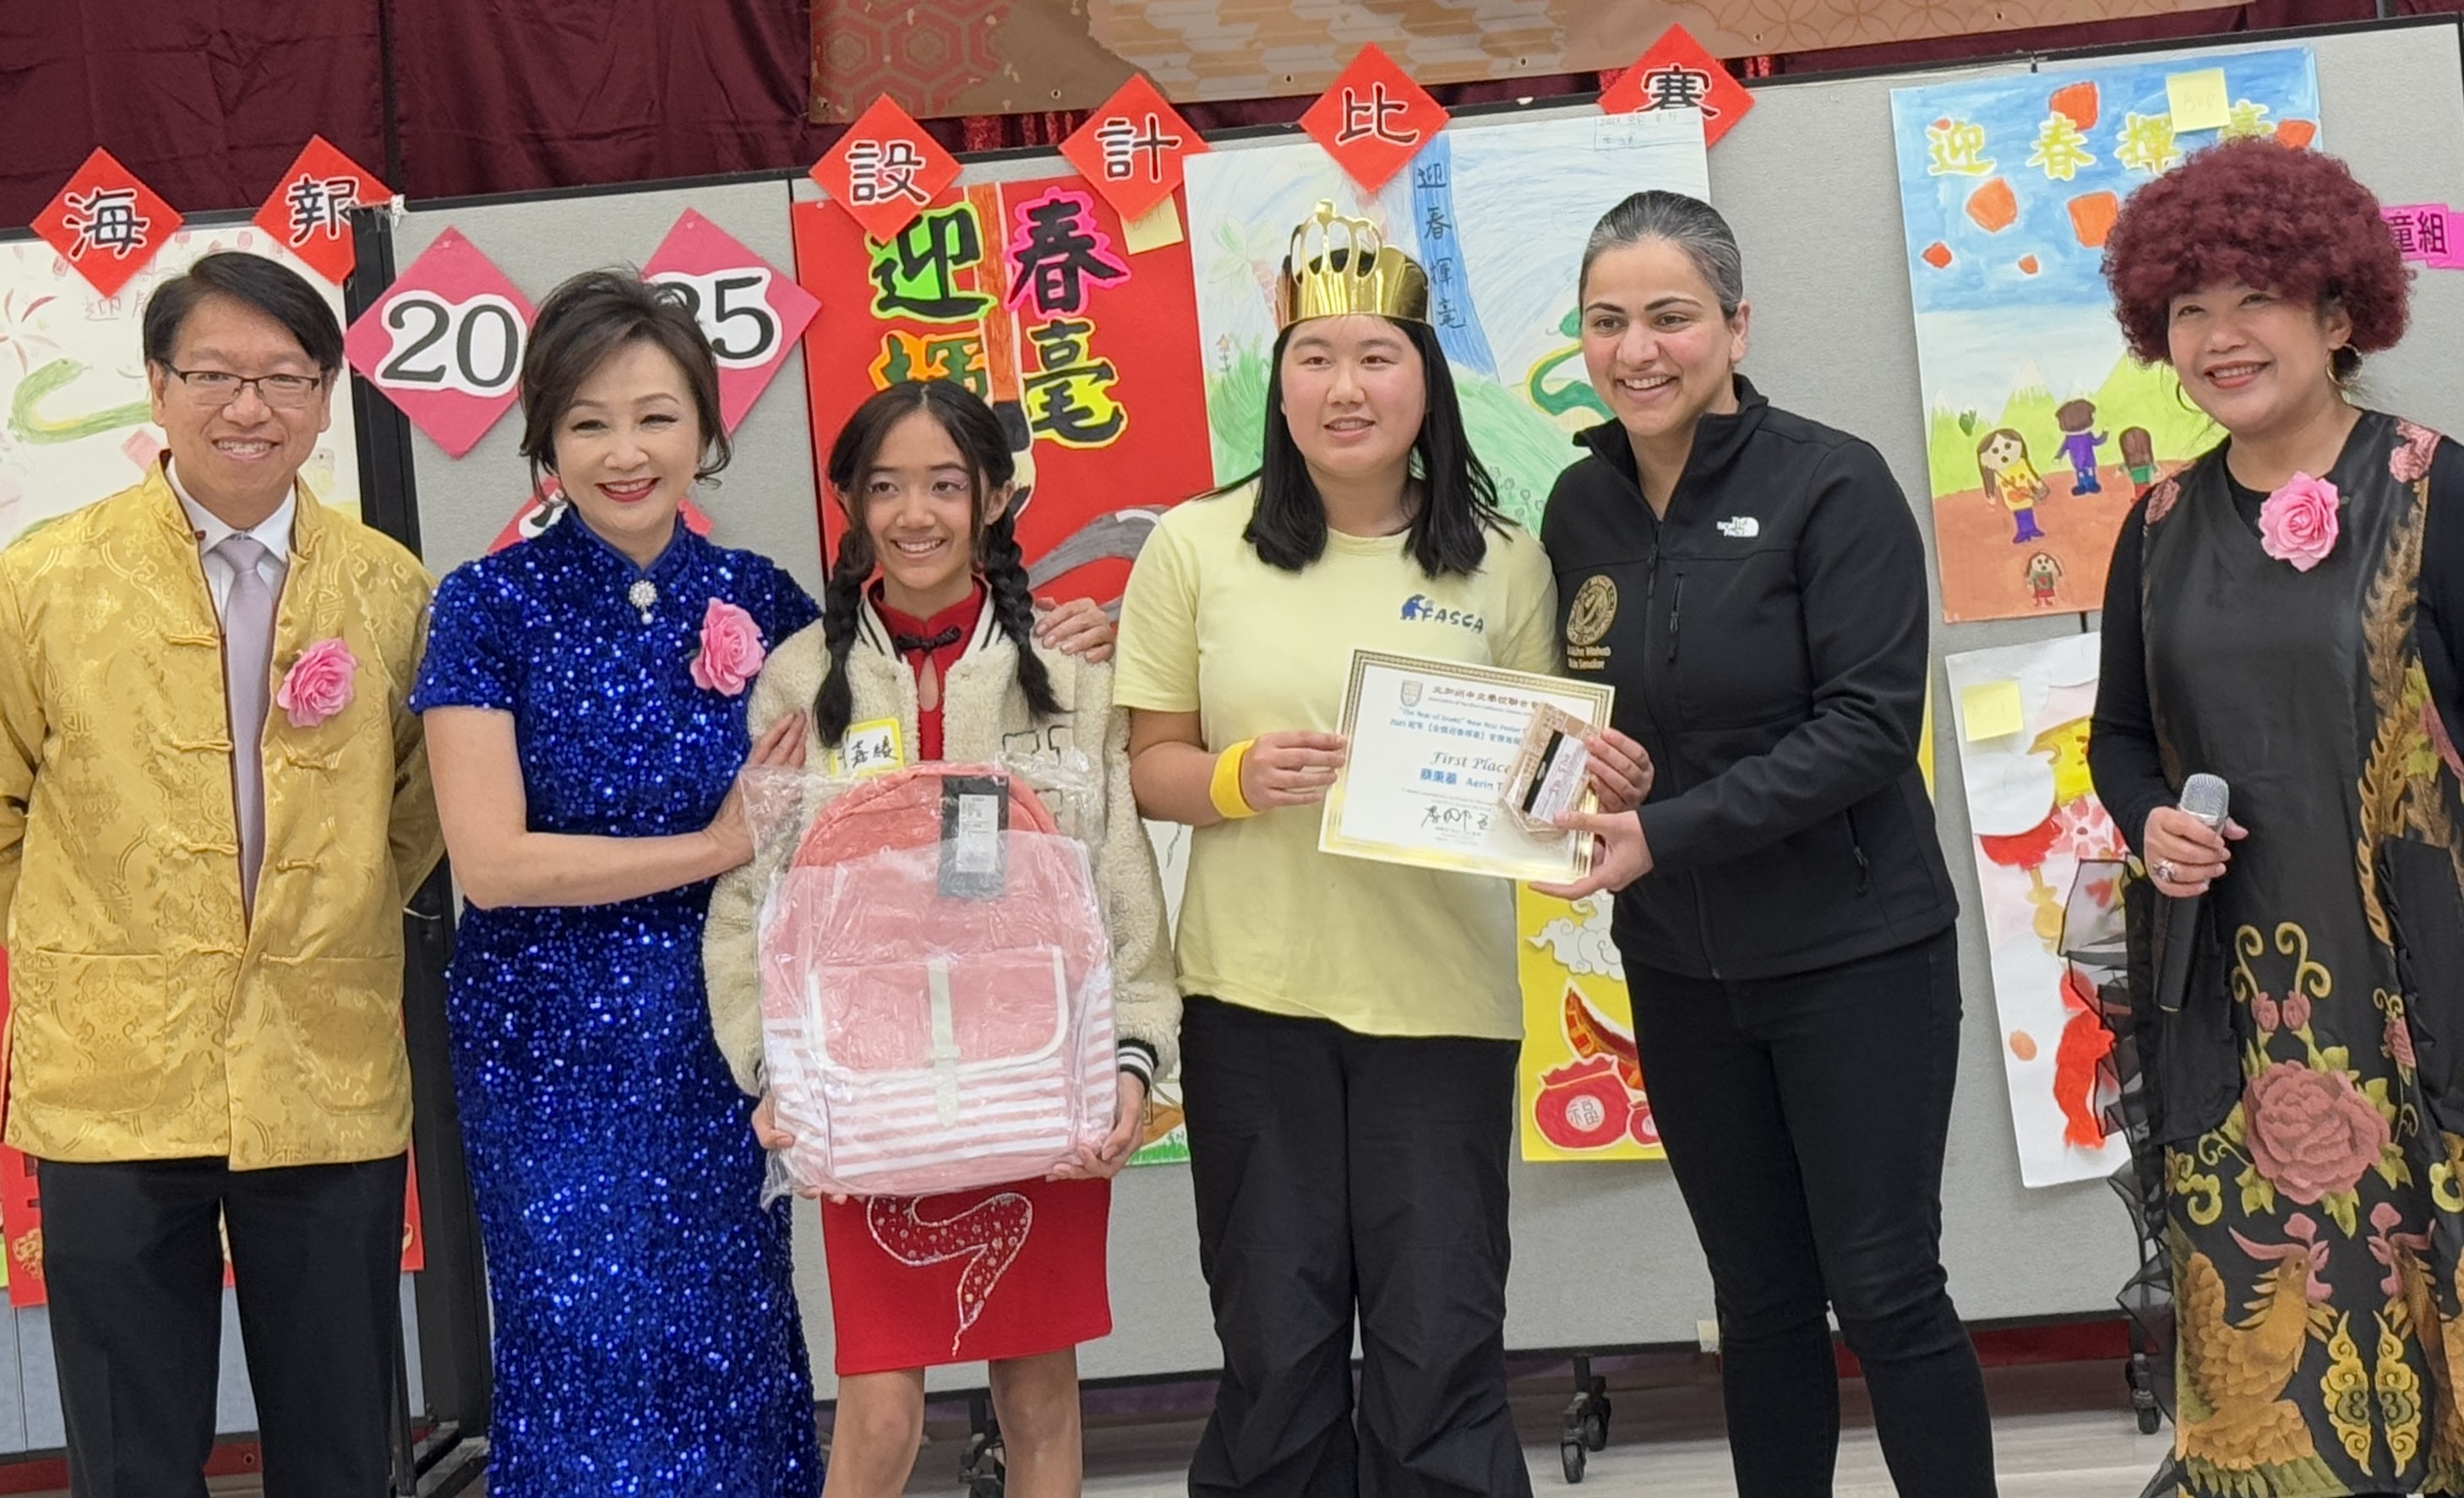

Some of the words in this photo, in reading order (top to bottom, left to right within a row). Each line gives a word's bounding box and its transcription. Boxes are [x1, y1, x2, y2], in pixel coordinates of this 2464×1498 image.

[66, 188, 146, 257] 海
[291, 176, 358, 245] 報
[848, 143, 929, 203] 設
[1098, 117, 1180, 179] 計
[1337, 85, 1418, 144] 比
[1637, 65, 1717, 117] 賽
[380, 298, 521, 389] 20
[1420, 607, 1485, 635] FASCA
[1430, 751, 1469, 768] First
[1472, 757, 1512, 775] Place
[1466, 776, 1494, 790] Aerin
